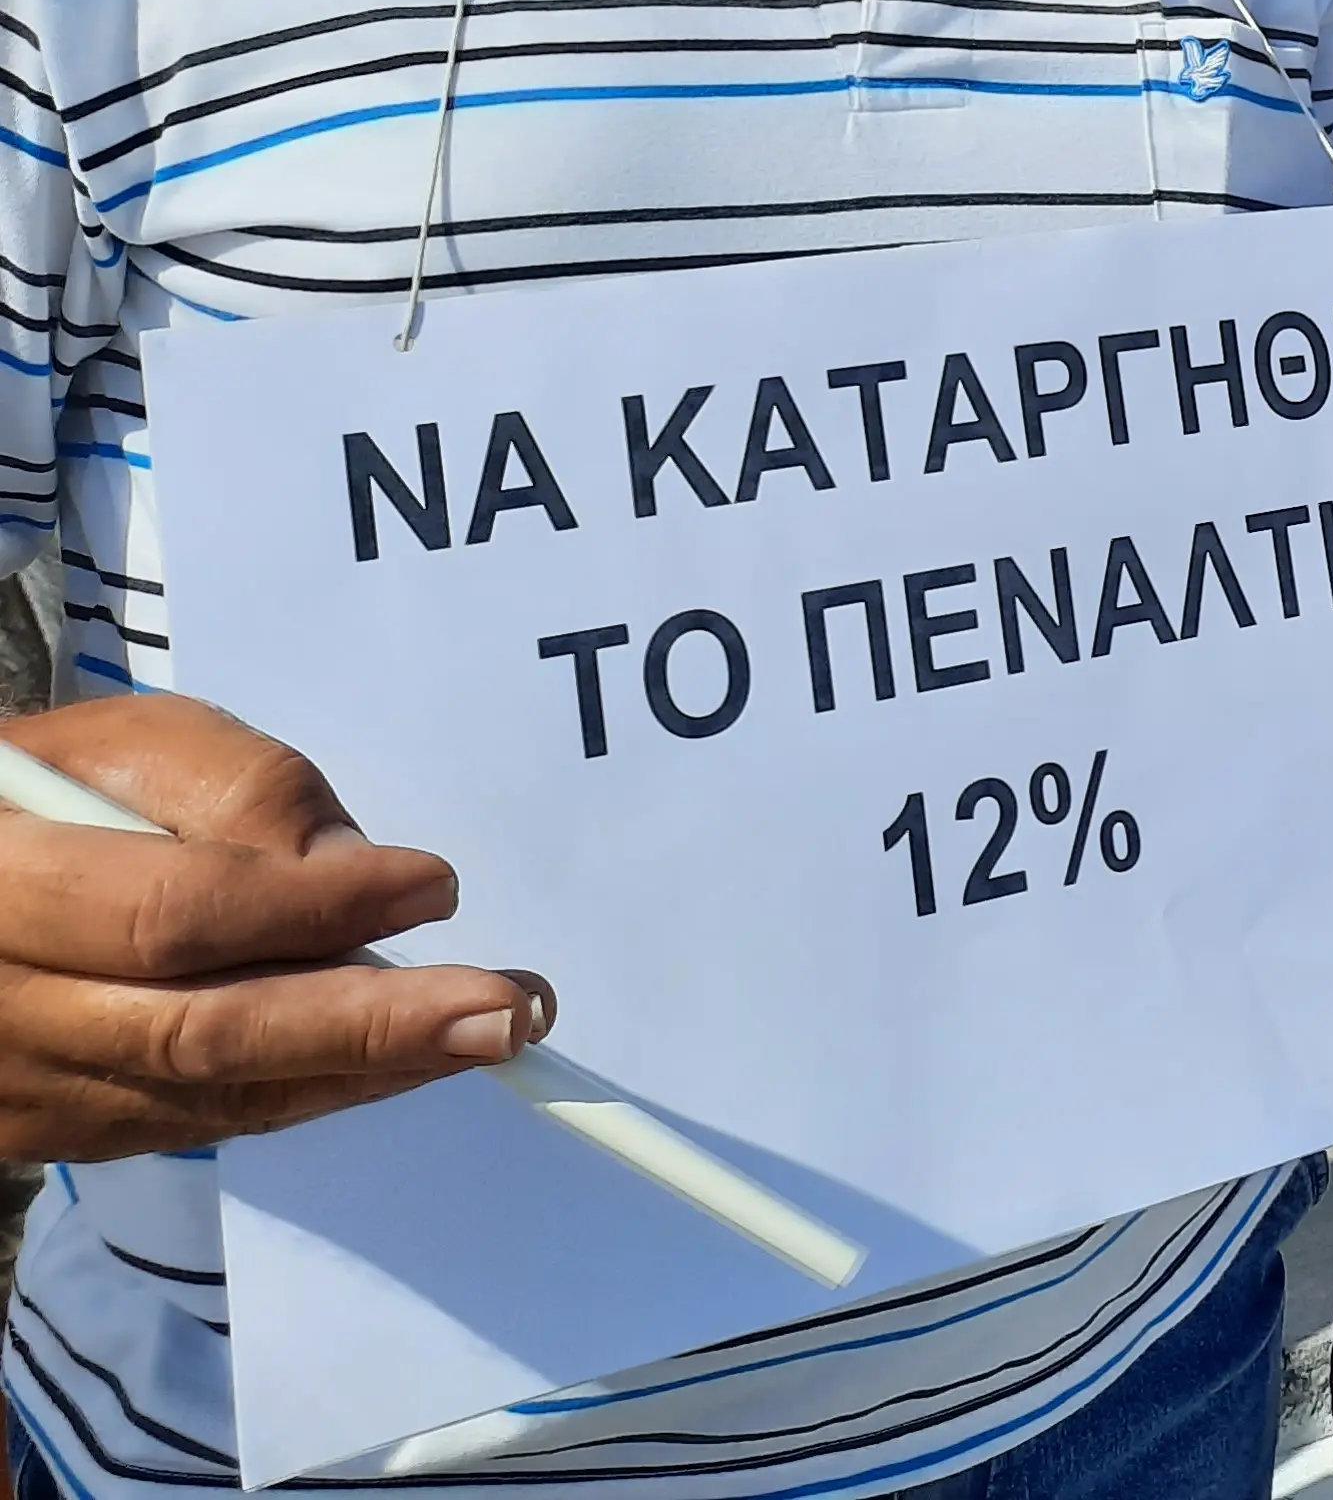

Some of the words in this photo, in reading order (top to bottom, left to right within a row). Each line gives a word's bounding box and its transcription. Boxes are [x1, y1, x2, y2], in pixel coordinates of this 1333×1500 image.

[342, 410, 579, 563] ΝΑ
[537, 608, 751, 760] ΤΟ
[882, 749, 1141, 918] 12%
